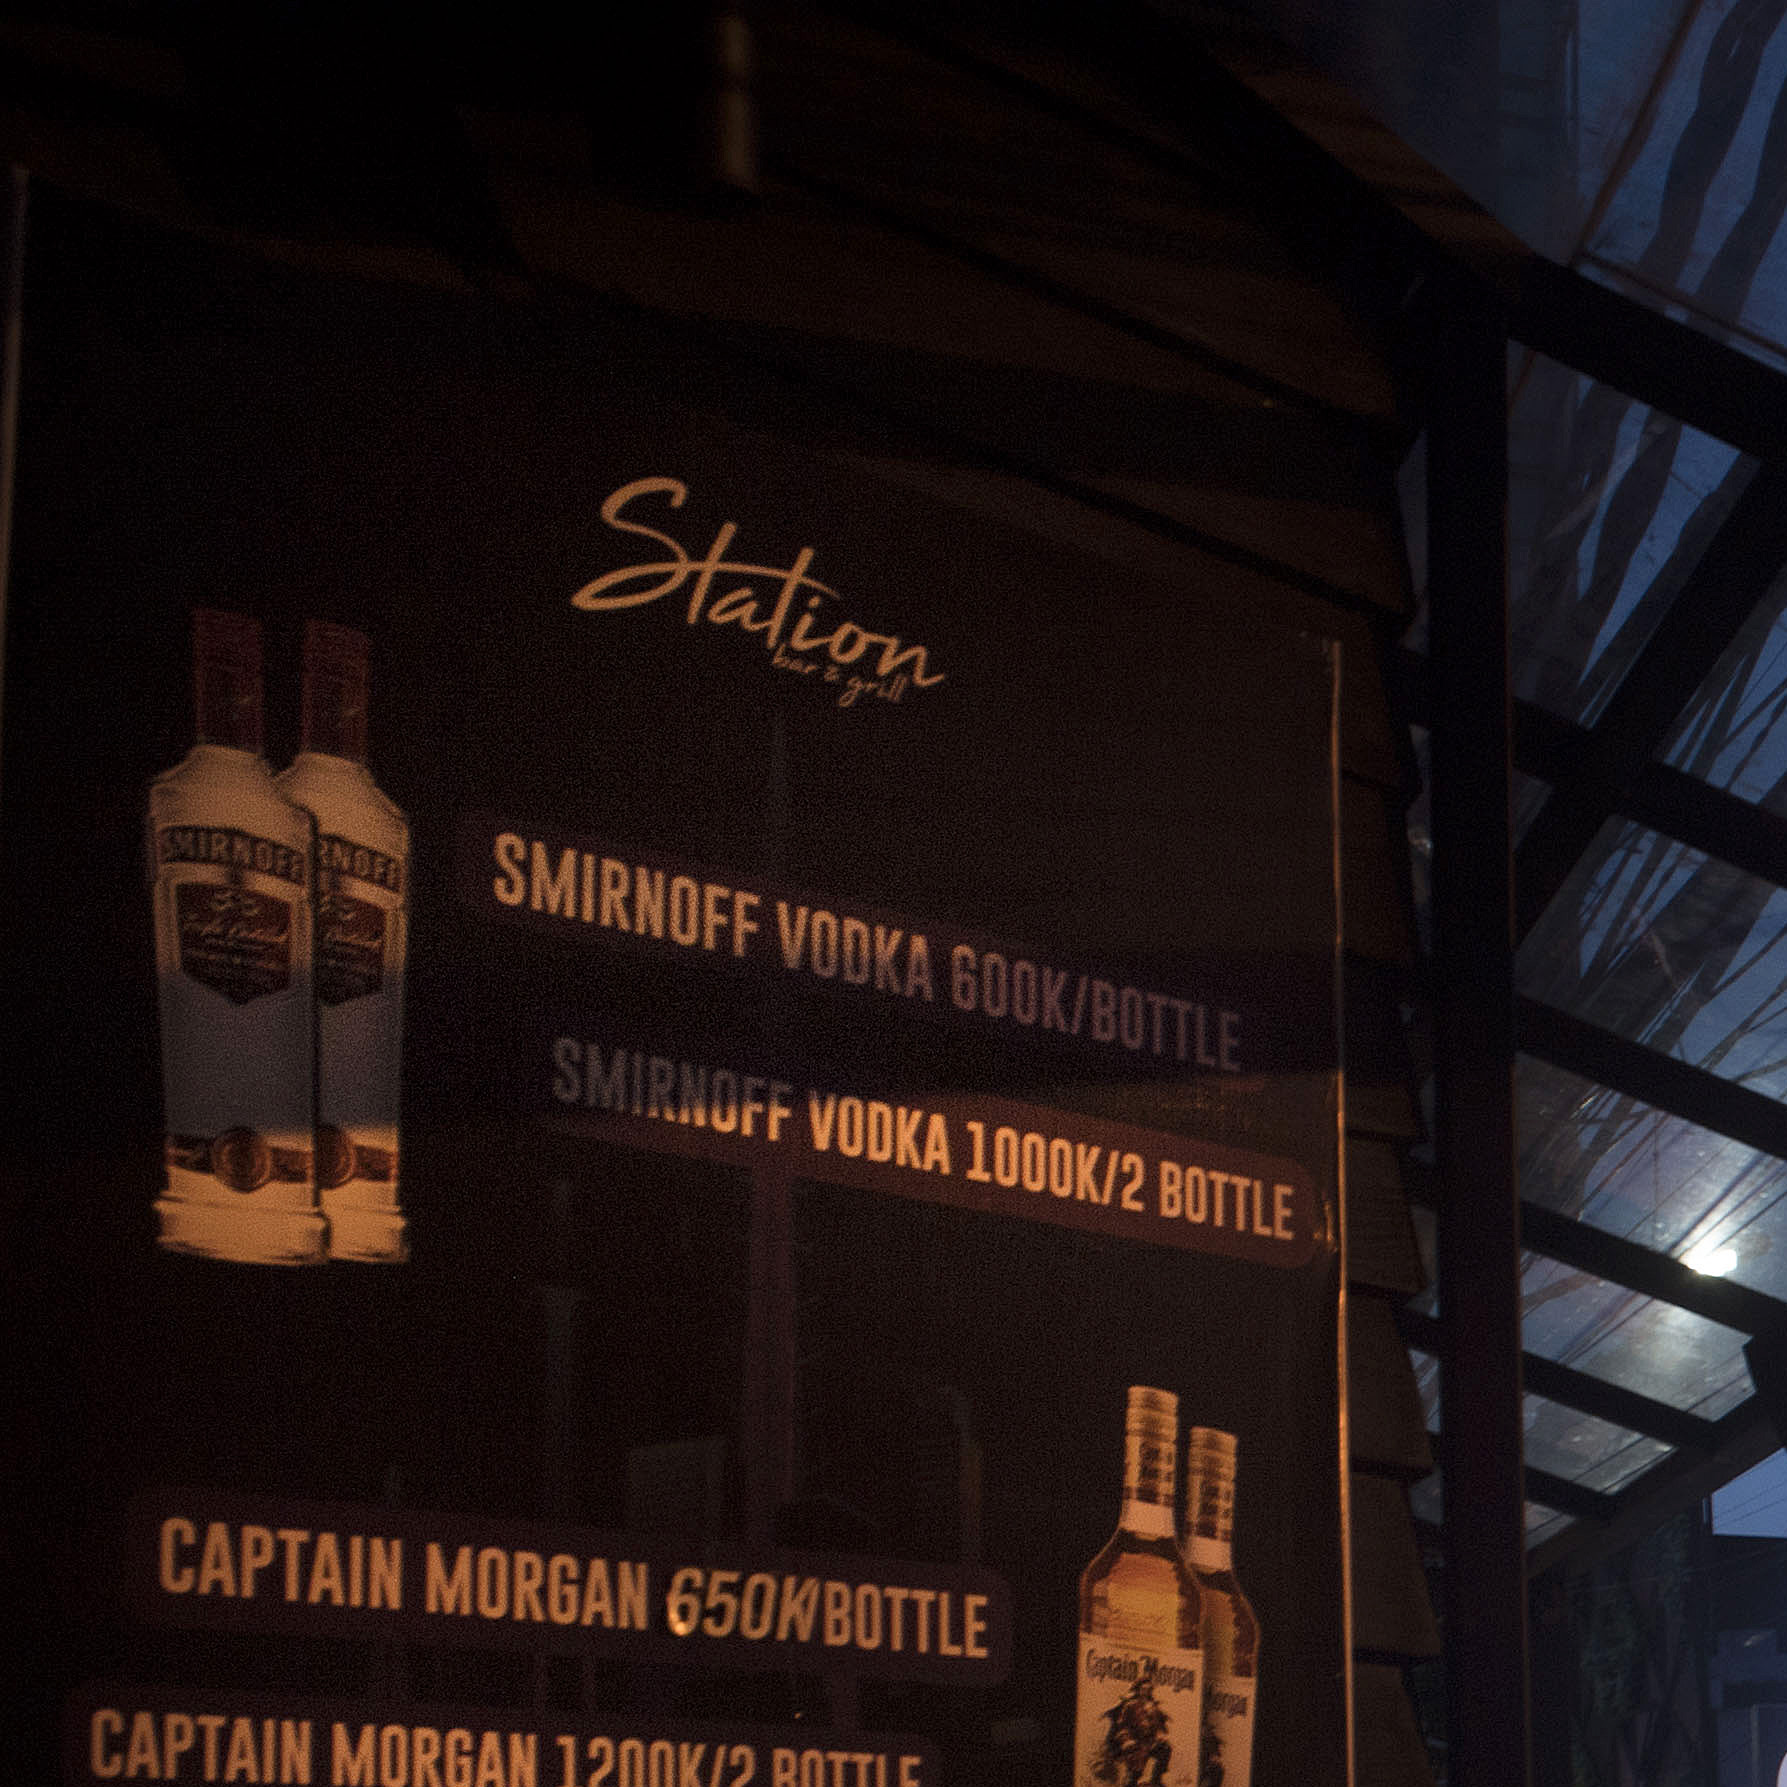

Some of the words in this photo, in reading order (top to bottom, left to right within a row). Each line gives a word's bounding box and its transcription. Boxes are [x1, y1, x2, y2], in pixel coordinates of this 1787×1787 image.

[570, 475, 946, 688] Station
[493, 832, 762, 958] SMIRNOFF
[776, 900, 935, 1002] VODKA
[951, 944, 1242, 1072] 600K/BOTTLE
[551, 1036, 794, 1142] SMIRNOFF
[808, 1088, 951, 1176] VODKA
[965, 1121, 1146, 1214] 1000K/2
[1159, 1160, 1295, 1241] BOTTLE
[158, 1516, 403, 1611] CAPTAIN
[423, 1541, 650, 1631] MORGAN
[89, 1708, 313, 1786] CAPTAIN
